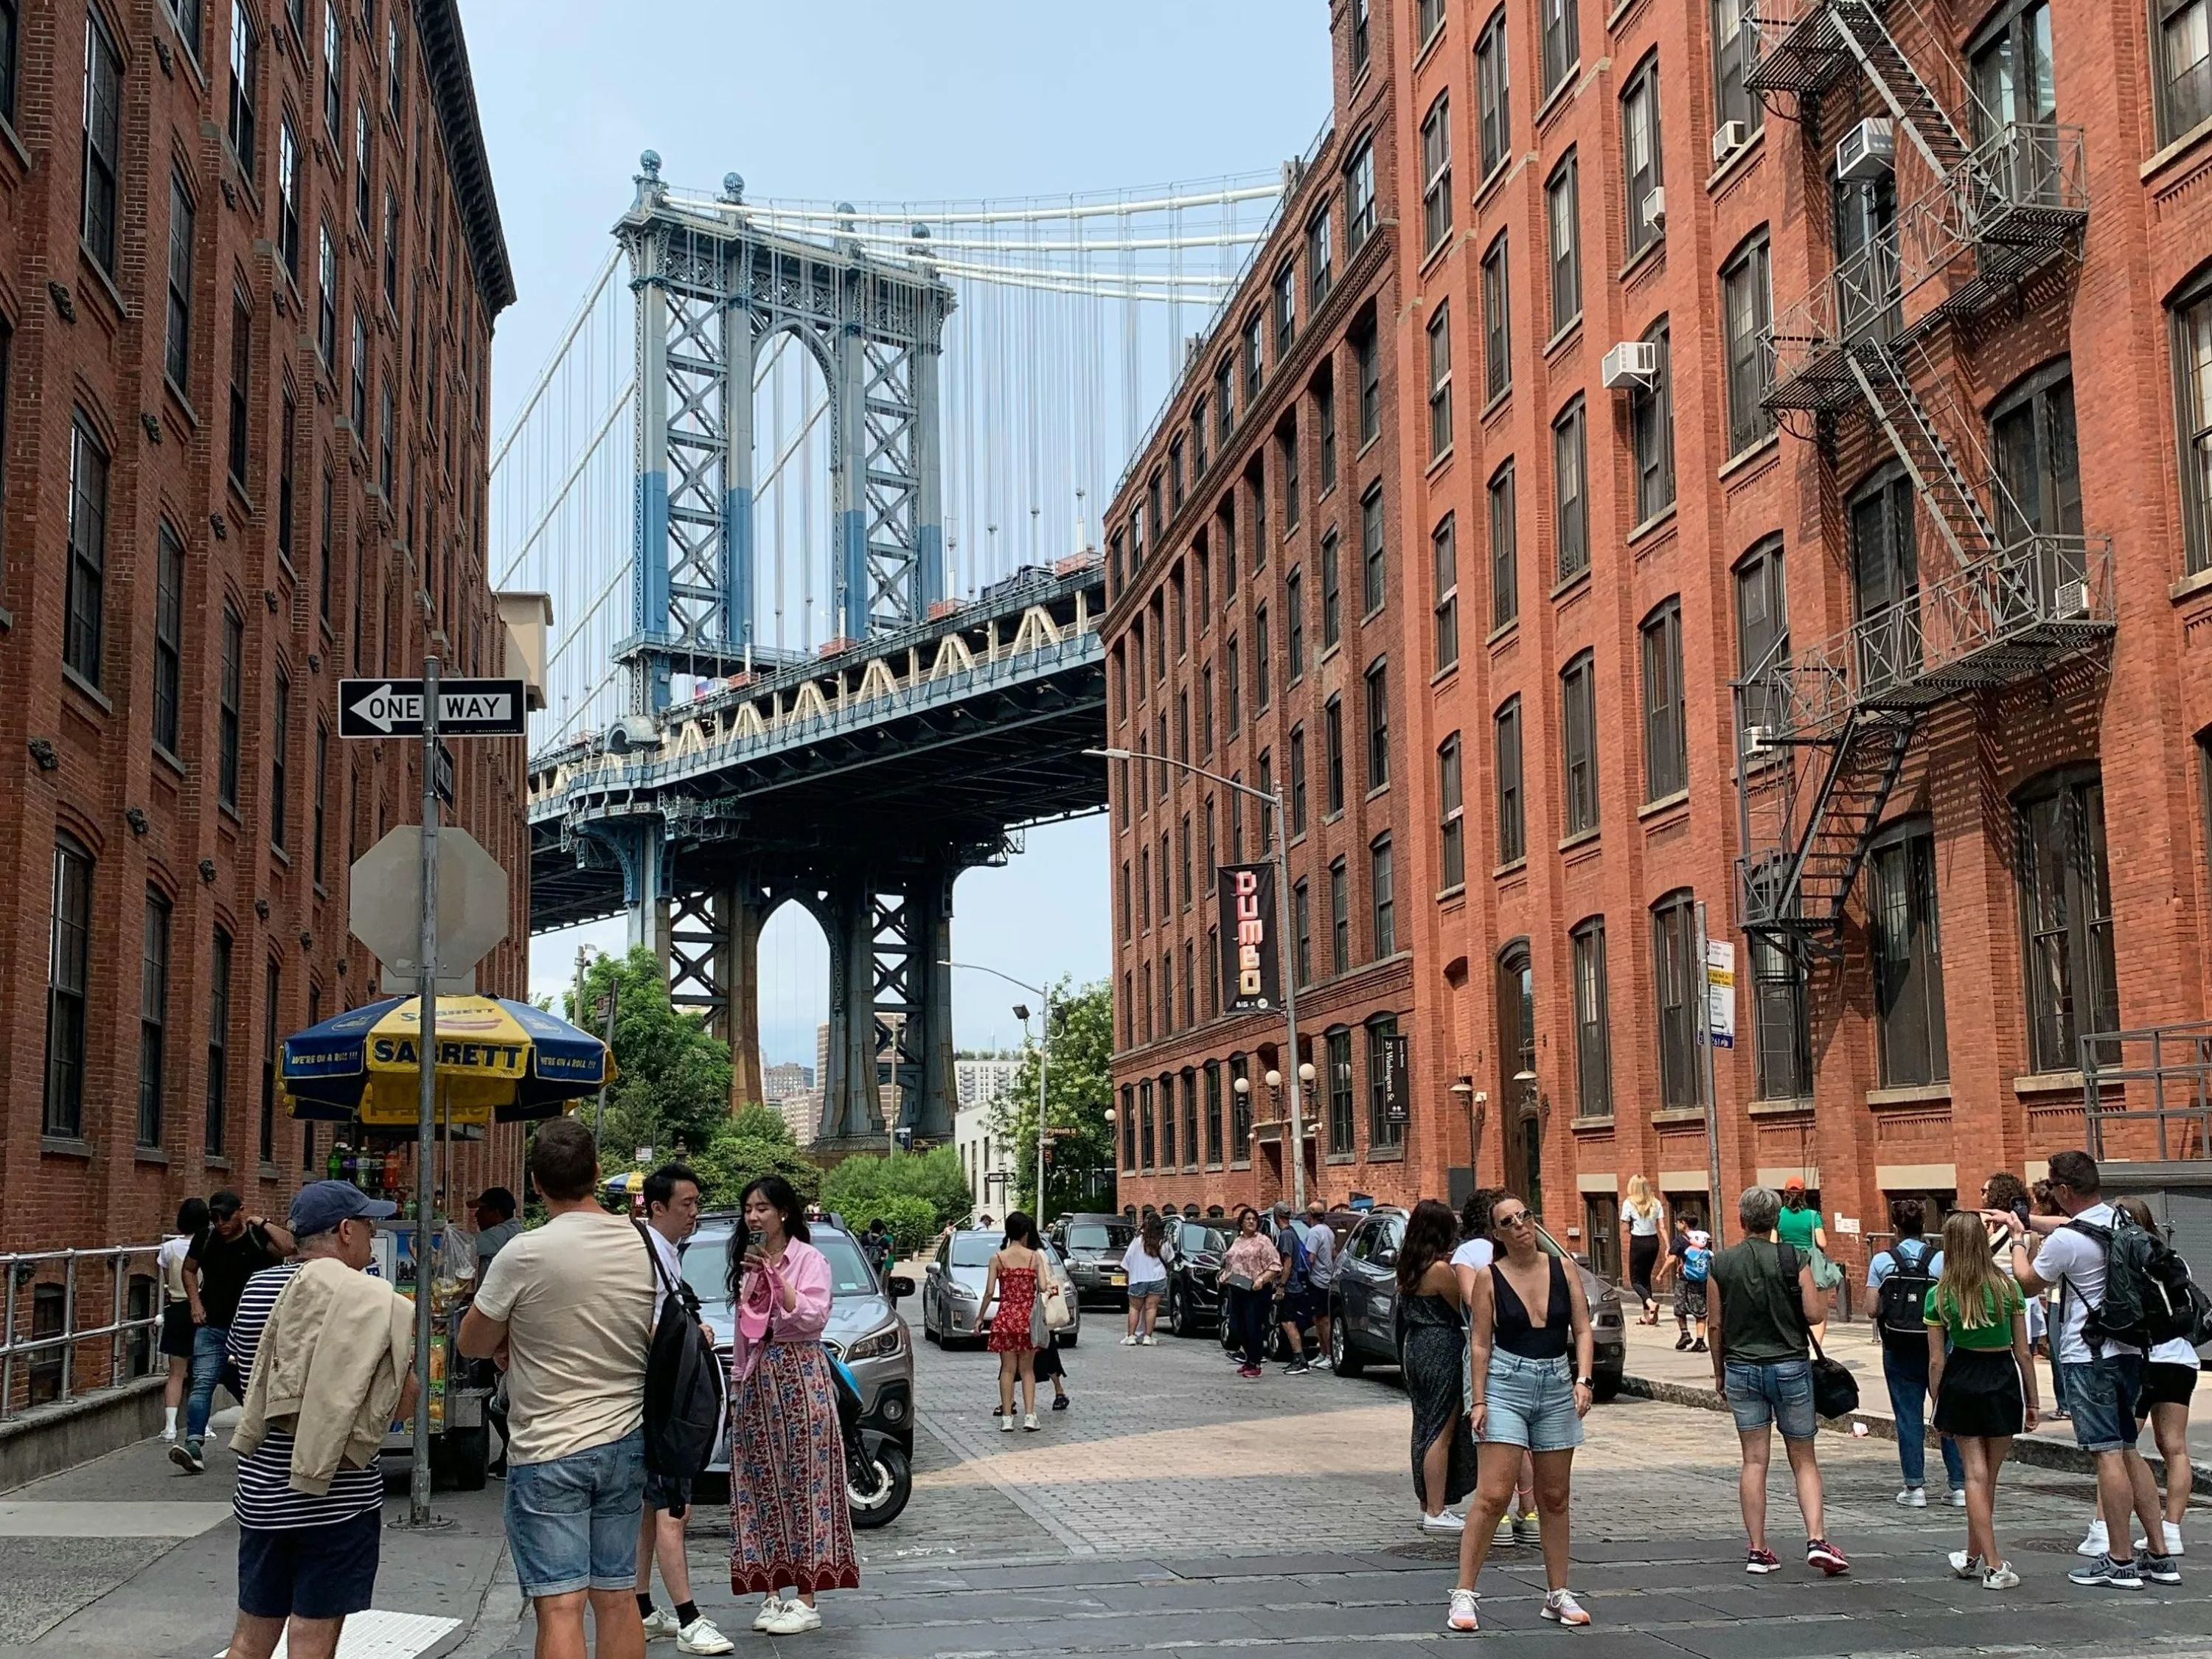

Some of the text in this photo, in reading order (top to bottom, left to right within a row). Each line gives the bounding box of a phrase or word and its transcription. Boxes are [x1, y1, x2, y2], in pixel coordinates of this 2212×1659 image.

[369, 697, 501, 719] ONE WAY
[1236, 871, 1264, 995] DUMBO
[400, 1008, 495, 1021] SBRETT
[375, 1039, 522, 1068] SARETT
[1385, 1040, 1393, 1050] 25
[292, 1055, 316, 1064] WE'RE
[327, 1054, 333, 1062] A
[1385, 1051, 1394, 1092] Washington
[2113, 1568, 2135, 1579] AIR
